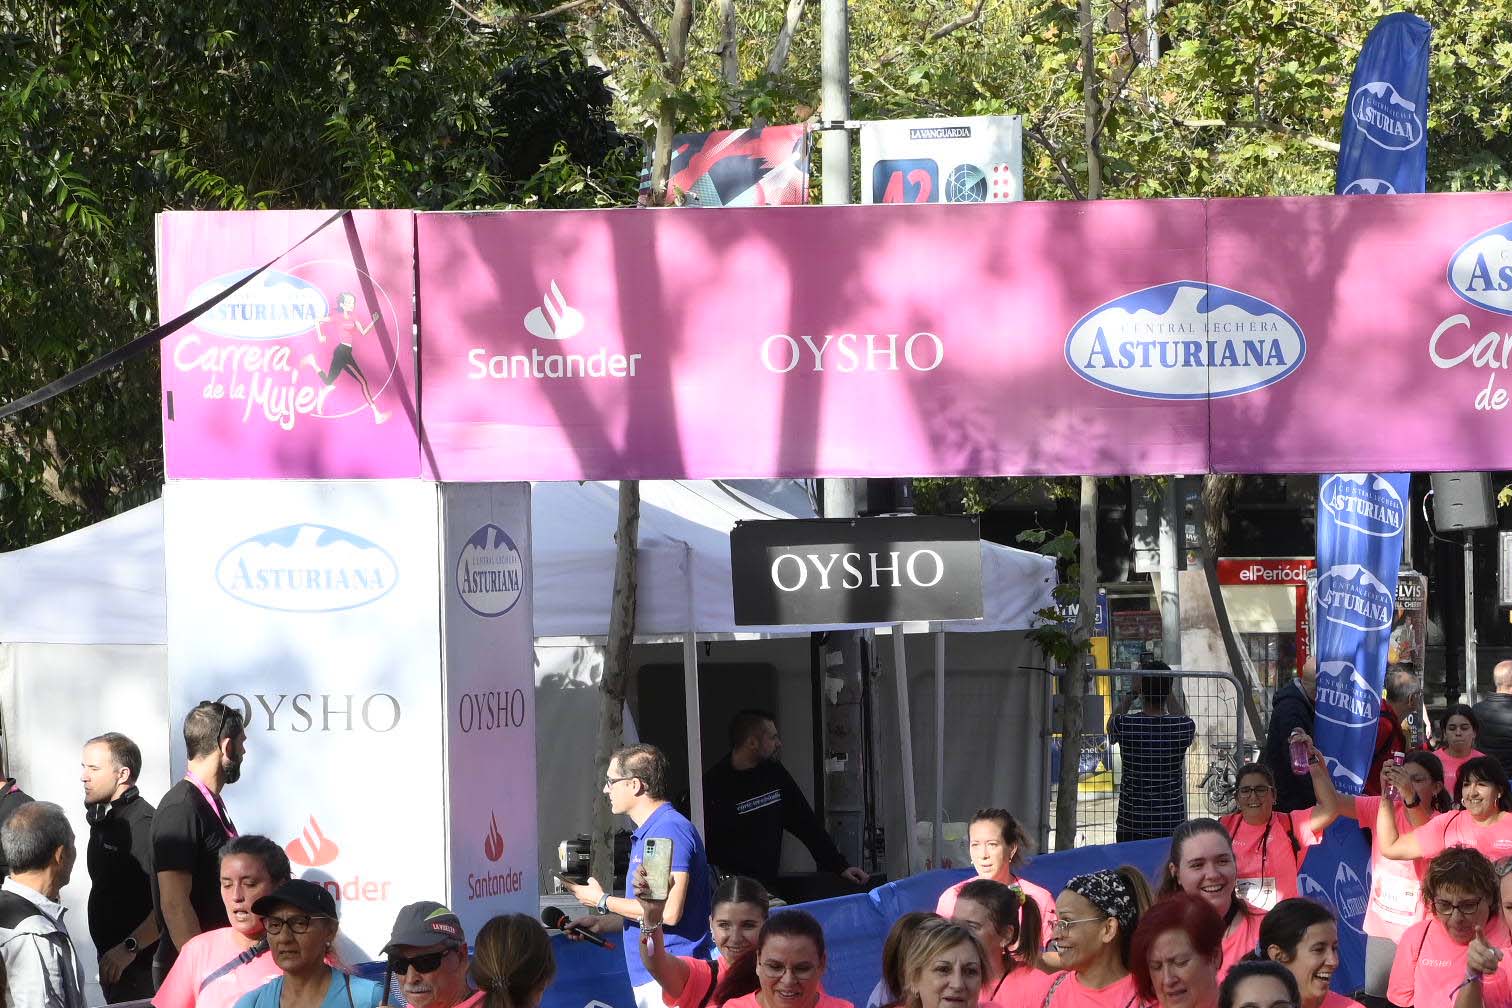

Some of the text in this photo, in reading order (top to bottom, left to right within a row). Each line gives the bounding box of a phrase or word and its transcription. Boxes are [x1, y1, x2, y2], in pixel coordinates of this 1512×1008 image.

[911, 127, 970, 139] LA VANGUARDIA
[1202, 321, 1279, 334] LECHERA
[173, 335, 291, 371] Carrera
[467, 347, 643, 379] Santander
[761, 331, 945, 374] OYSHO
[1083, 326, 1288, 369] ASTURIANA
[203, 369, 336, 431] de la Mujer
[1474, 372, 1511, 410] de
[1330, 484, 1400, 528] ASTURIANA
[230, 558, 386, 593] ASTURIANA
[462, 559, 520, 594] ASTURIANA
[771, 548, 945, 593] OYSHO
[217, 692, 401, 734] OYSHO
[459, 688, 525, 734] OYSHO
[468, 872, 523, 901] Santander
